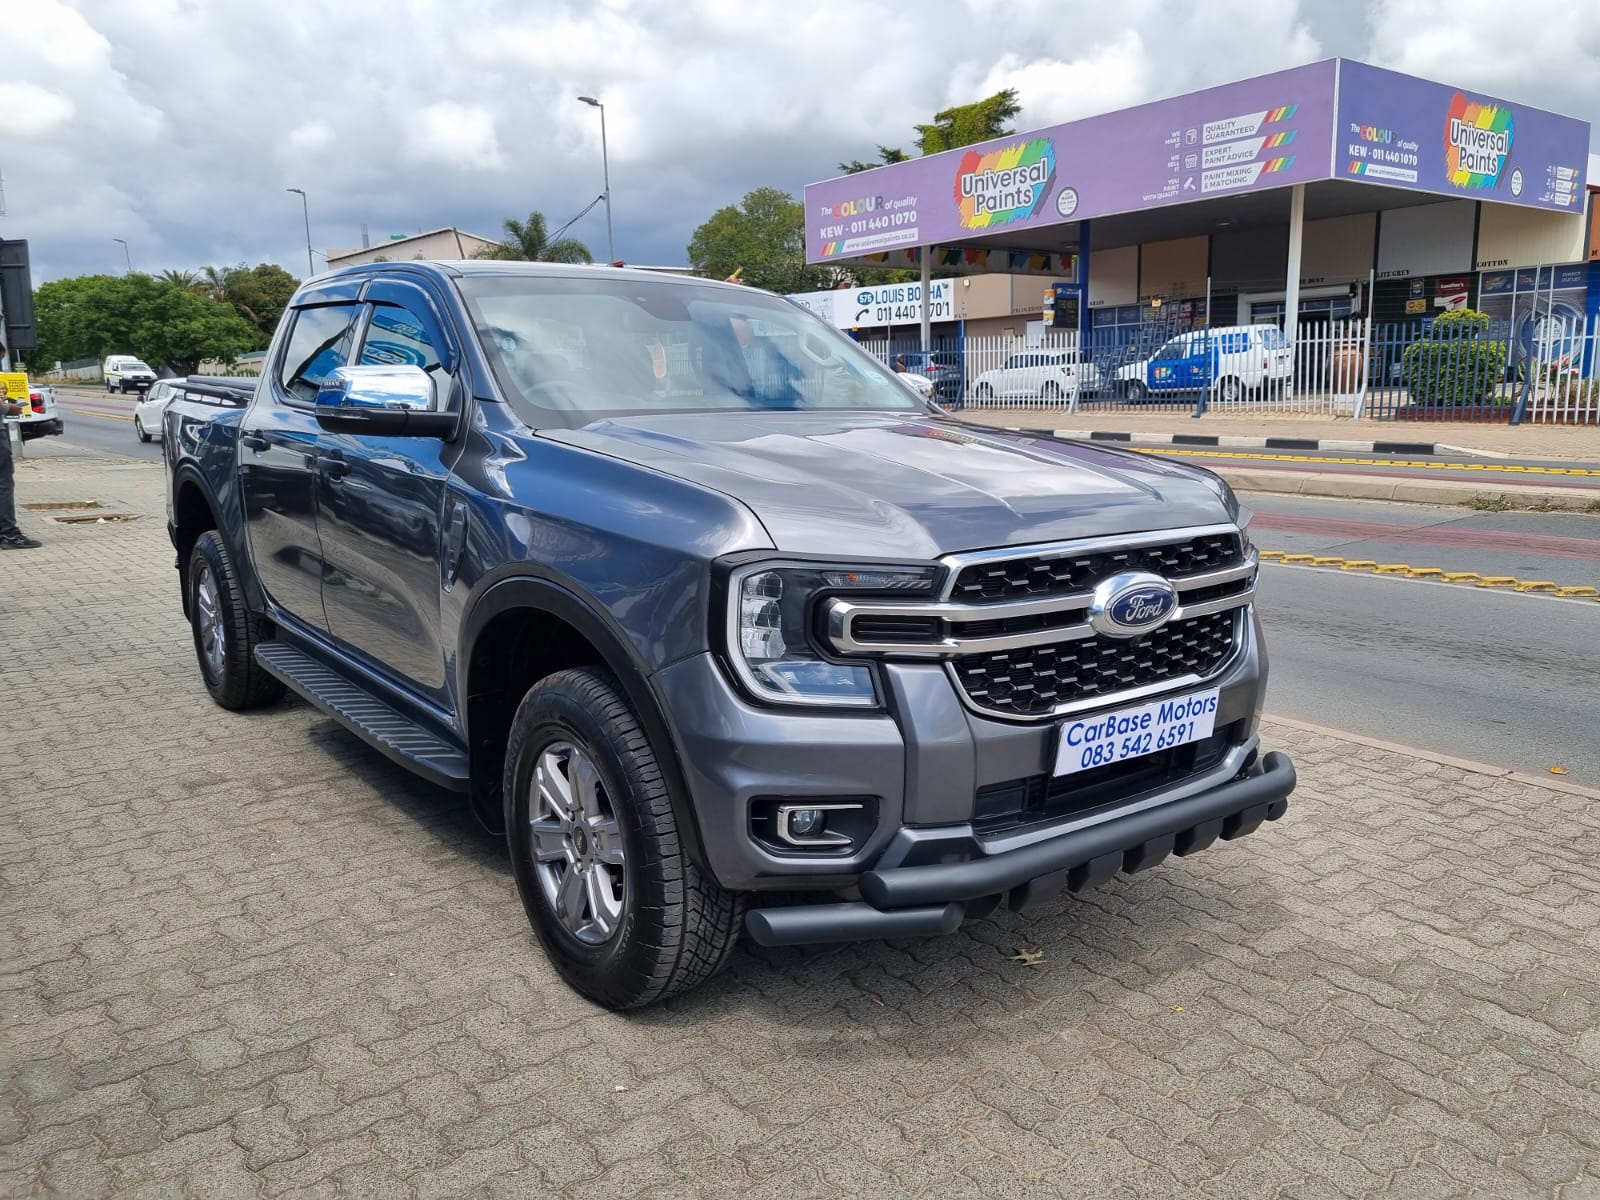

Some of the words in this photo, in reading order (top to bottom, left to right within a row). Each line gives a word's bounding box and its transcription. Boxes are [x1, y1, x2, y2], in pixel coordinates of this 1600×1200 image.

[1205, 120, 1237, 133] QUALITY
[1205, 125, 1255, 141] GUARANTEED
[1350, 123, 1360, 133] The
[1451, 120, 1508, 153] Universal
[1205, 146, 1233, 157] EXPERT
[1205, 155, 1226, 165] PAINT
[1227, 150, 1254, 161] ADVICE
[1349, 144, 1368, 158] KEW
[1372, 148, 1384, 160] 011
[1385, 150, 1400, 163] 440
[1400, 153, 1418, 166] 1070
[1459, 146, 1497, 174] Paints
[962, 158, 1047, 196] Universal
[1204, 172, 1225, 181] PAINT
[1226, 167, 1253, 178] MIXING
[1209, 176, 1248, 188] MATCHING
[821, 207, 832, 216] The
[833, 196, 884, 219] COLOUR
[885, 200, 893, 210] of
[893, 196, 918, 210] quality
[976, 186, 1032, 213] Paints
[820, 224, 844, 239] KEW
[851, 220, 866, 233] 011
[868, 216, 889, 230] 440
[890, 210, 917, 226] 1070
[1476, 259, 1508, 268] COTTON
[875, 288, 905, 305] LOUIS
[907, 284, 942, 302] BOHA
[877, 306, 892, 321] 011
[895, 304, 916, 320] 440
[1126, 594, 1163, 621] Ford
[1066, 711, 1151, 747] CarBase
[1156, 695, 1217, 726] Motors
[1080, 741, 1115, 769] 083
[1119, 733, 1152, 759] 542
[1156, 721, 1195, 750] 6591
